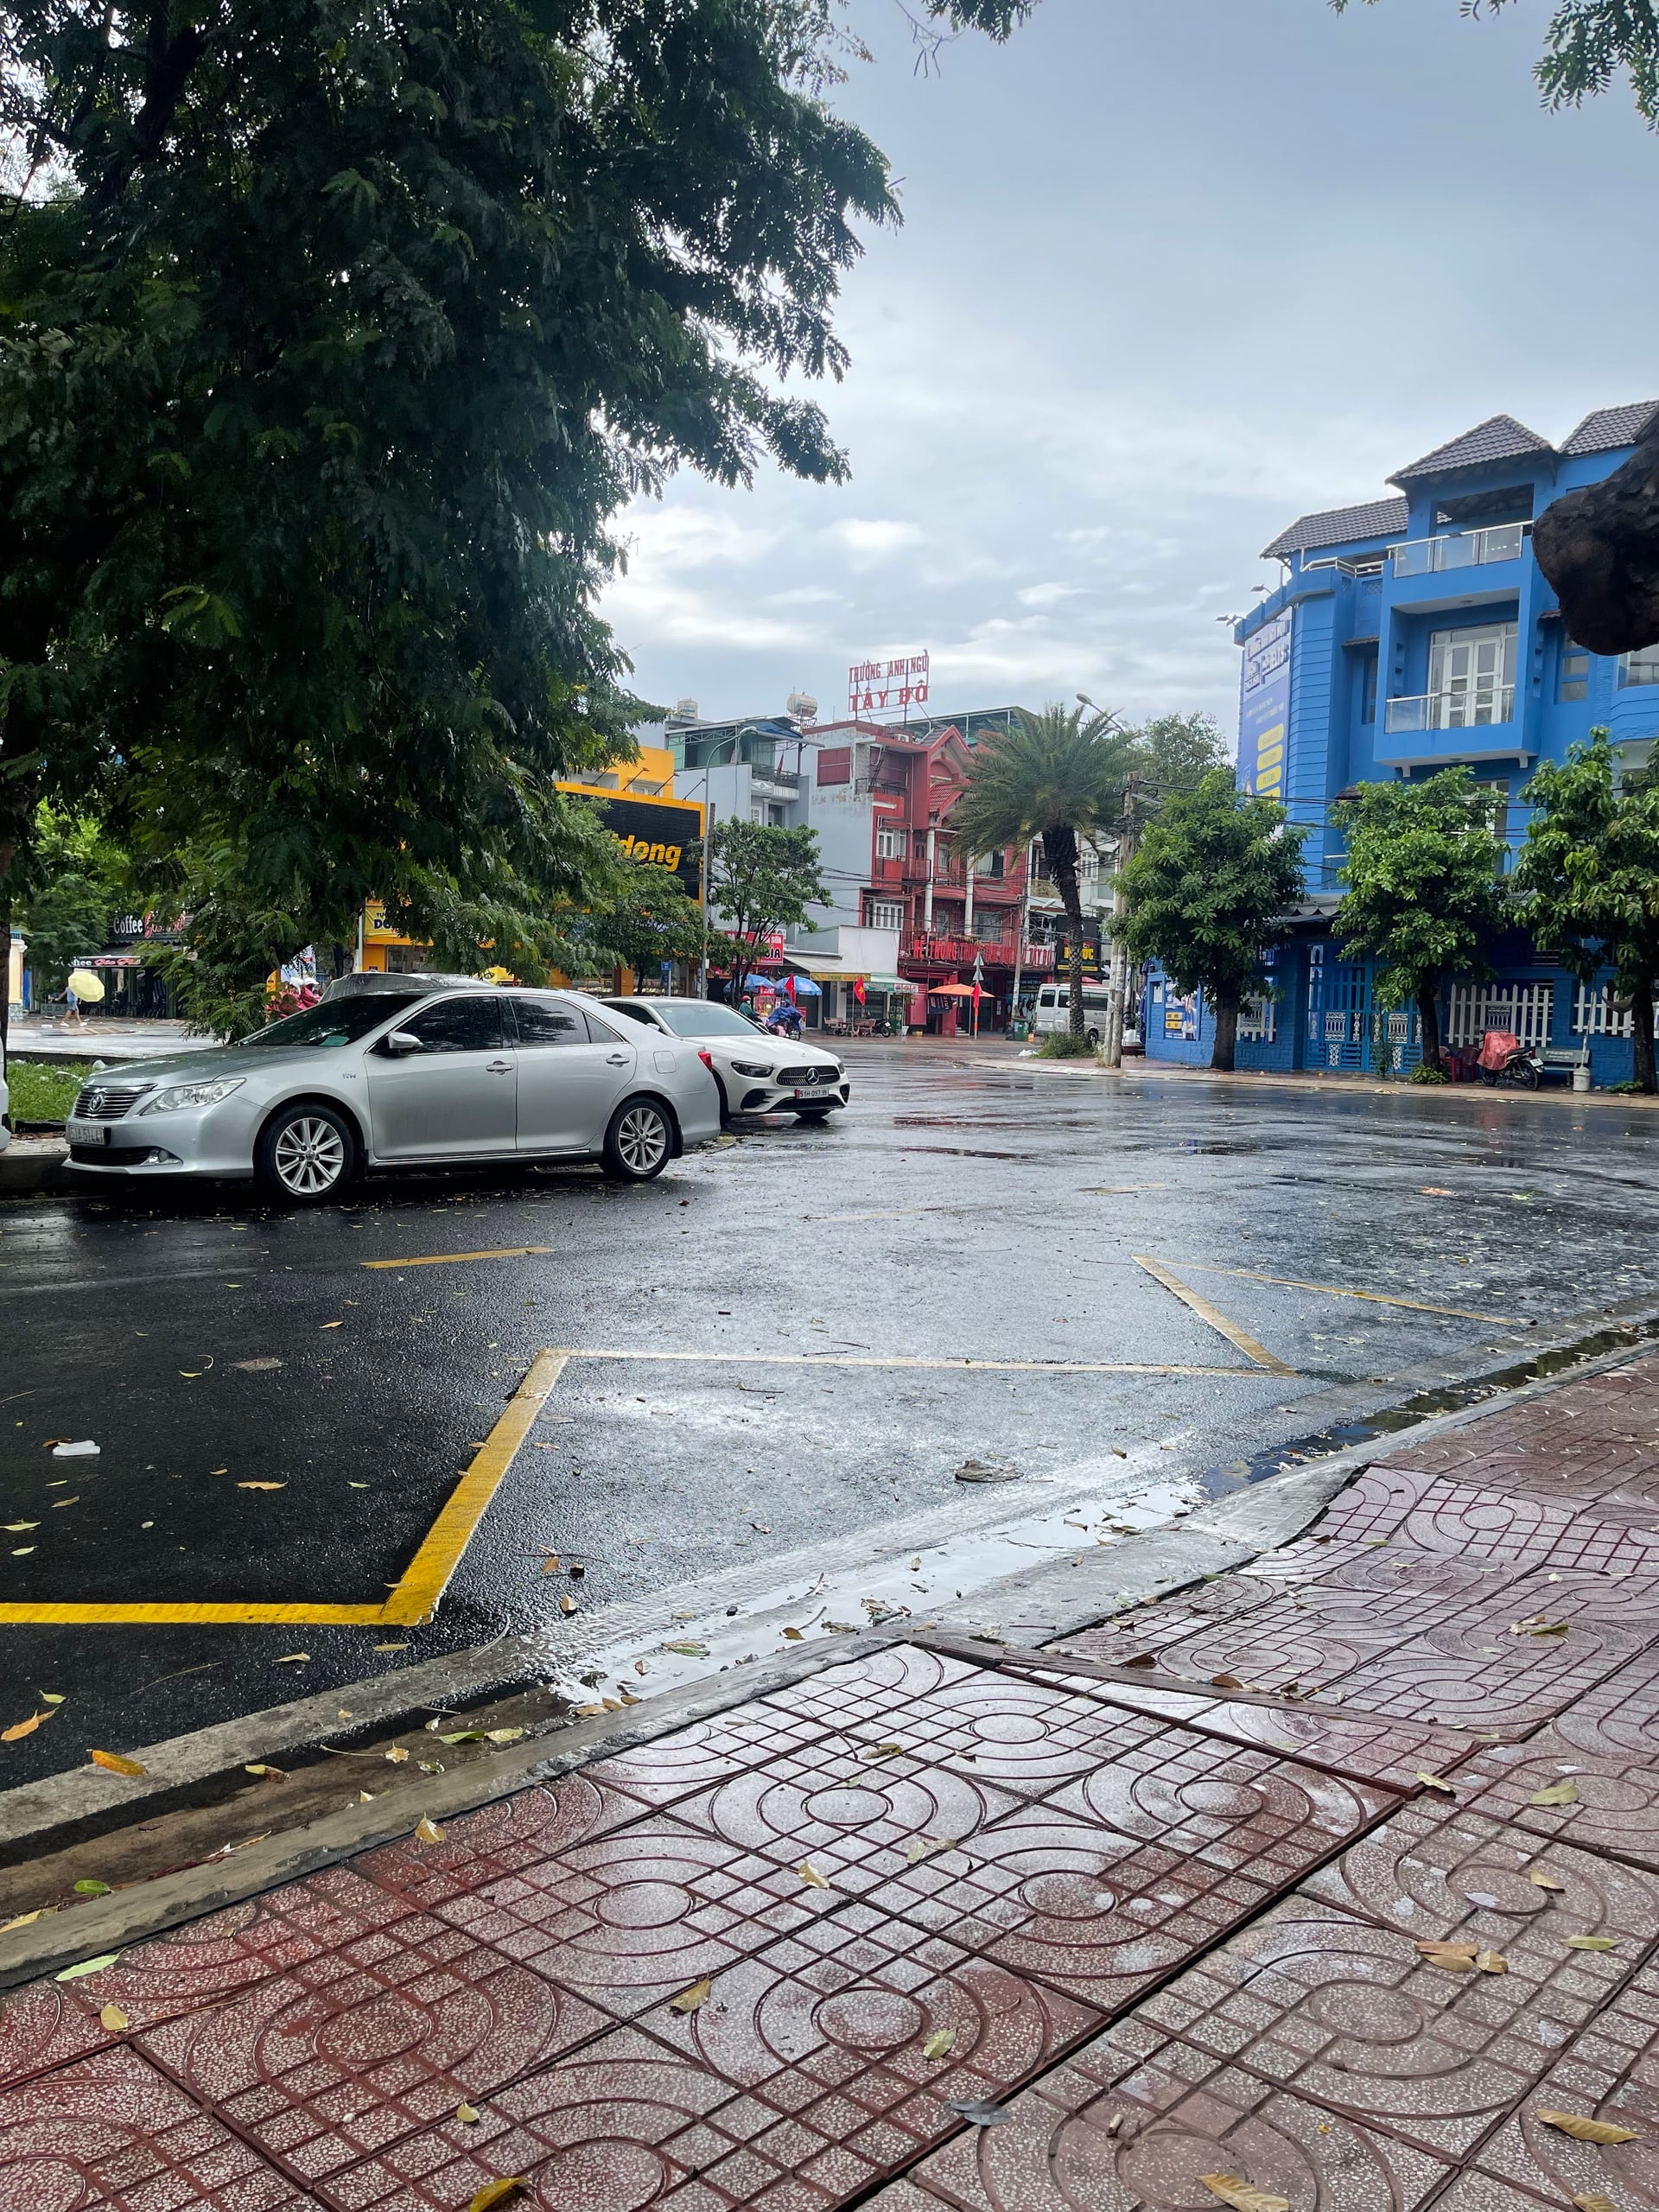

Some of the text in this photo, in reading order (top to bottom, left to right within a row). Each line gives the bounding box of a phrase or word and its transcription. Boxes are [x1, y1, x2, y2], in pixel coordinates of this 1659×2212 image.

[888, 658, 905, 677] ANH
[849, 679, 927, 712] TÂY ĐÔ
[610, 833, 682, 872] dong
[113, 915, 143, 934] Coffee
